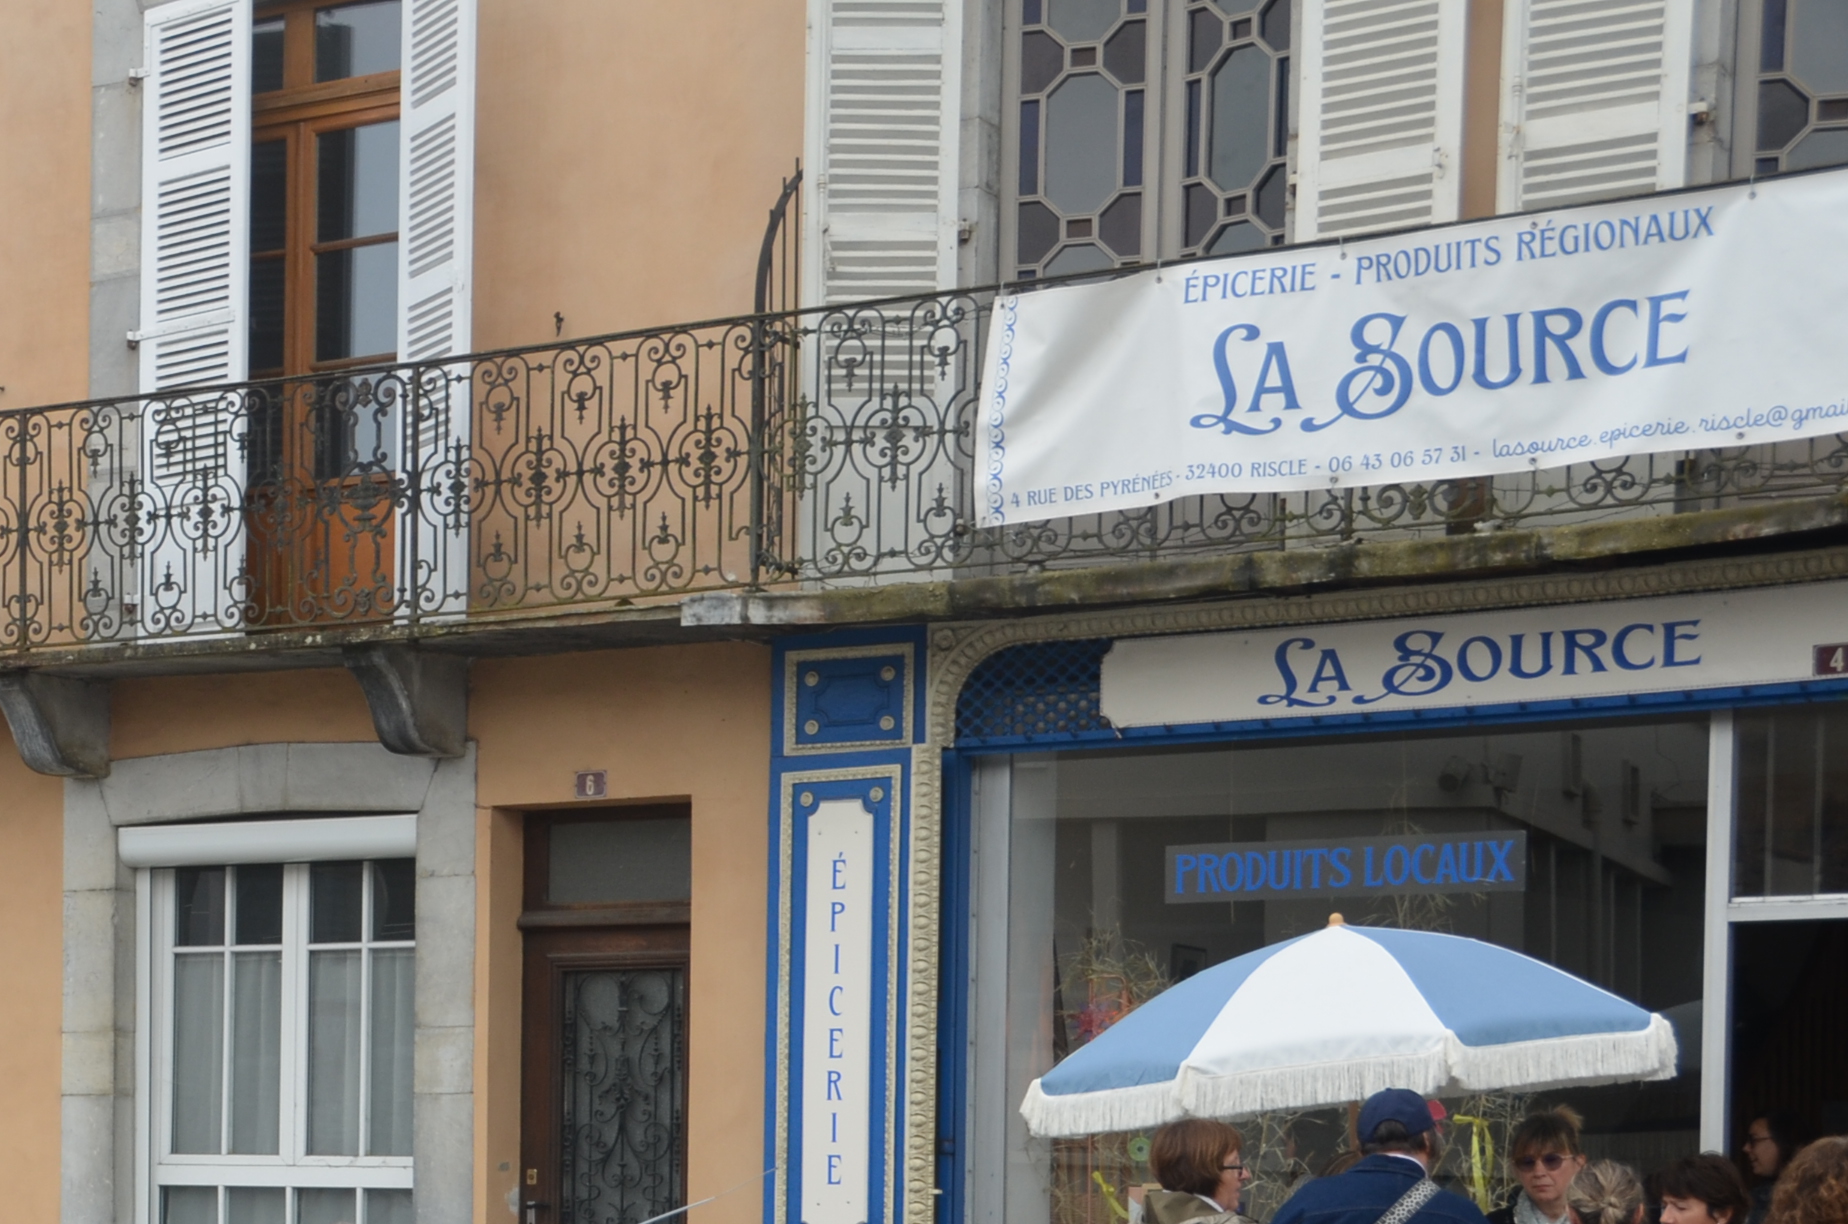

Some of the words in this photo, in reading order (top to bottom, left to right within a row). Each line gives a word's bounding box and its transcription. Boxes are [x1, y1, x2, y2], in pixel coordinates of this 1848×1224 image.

[1183, 262, 1316, 304] ÉPICERIE
[1354, 235, 1502, 285] PRODUITS
[1515, 205, 1715, 262] RÉGIONAUX
[1189, 323, 1303, 436] LA
[1299, 288, 1691, 433] SOURCE
[1010, 492, 1021, 508] 4
[1026, 487, 1057, 507] RUE
[1063, 483, 1094, 502] DES
[1099, 469, 1173, 498] PYRÉNÉES
[1184, 462, 1243, 481] 32400
[1250, 458, 1308, 478] RISCLE
[1328, 455, 1353, 473] 06
[1359, 453, 1383, 471] 43
[1389, 450, 1415, 469] 06
[1421, 447, 1443, 466] 57
[1449, 445, 1467, 463] 31
[1492, 398, 1848, 459] lasource.epicerie.riscle@gmai
[1256, 637, 1352, 708] LA
[1351, 618, 1702, 705] SOURCE
[1829, 647, 1844, 672] 4
[585, 774, 595, 796] 6
[1174, 846, 1352, 894] PRODUITS
[1362, 839, 1515, 888] LOCAUX
[825, 851, 847, 1186] ÉPICERIE
